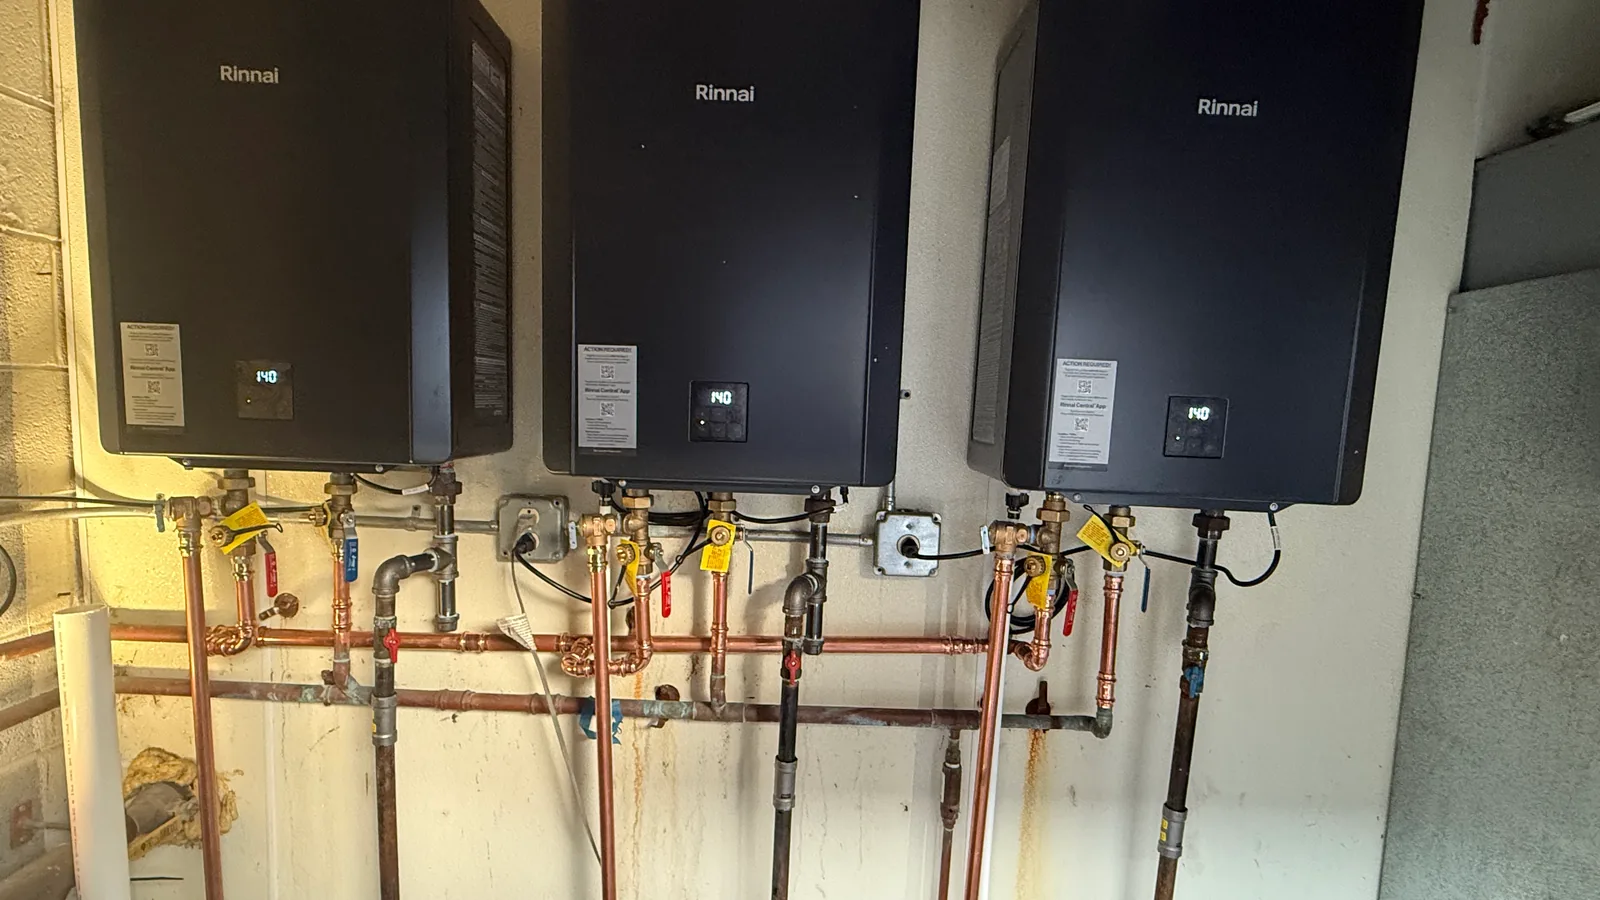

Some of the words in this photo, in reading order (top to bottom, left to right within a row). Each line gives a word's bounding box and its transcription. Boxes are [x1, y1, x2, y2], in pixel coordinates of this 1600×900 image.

[220, 65, 279, 84] Rinnai
[696, 84, 755, 102] Rinnai
[1198, 98, 1259, 117] Rinnai
[256, 370, 278, 384] 140
[711, 390, 732, 405] 140
[1188, 406, 1210, 421] 140
